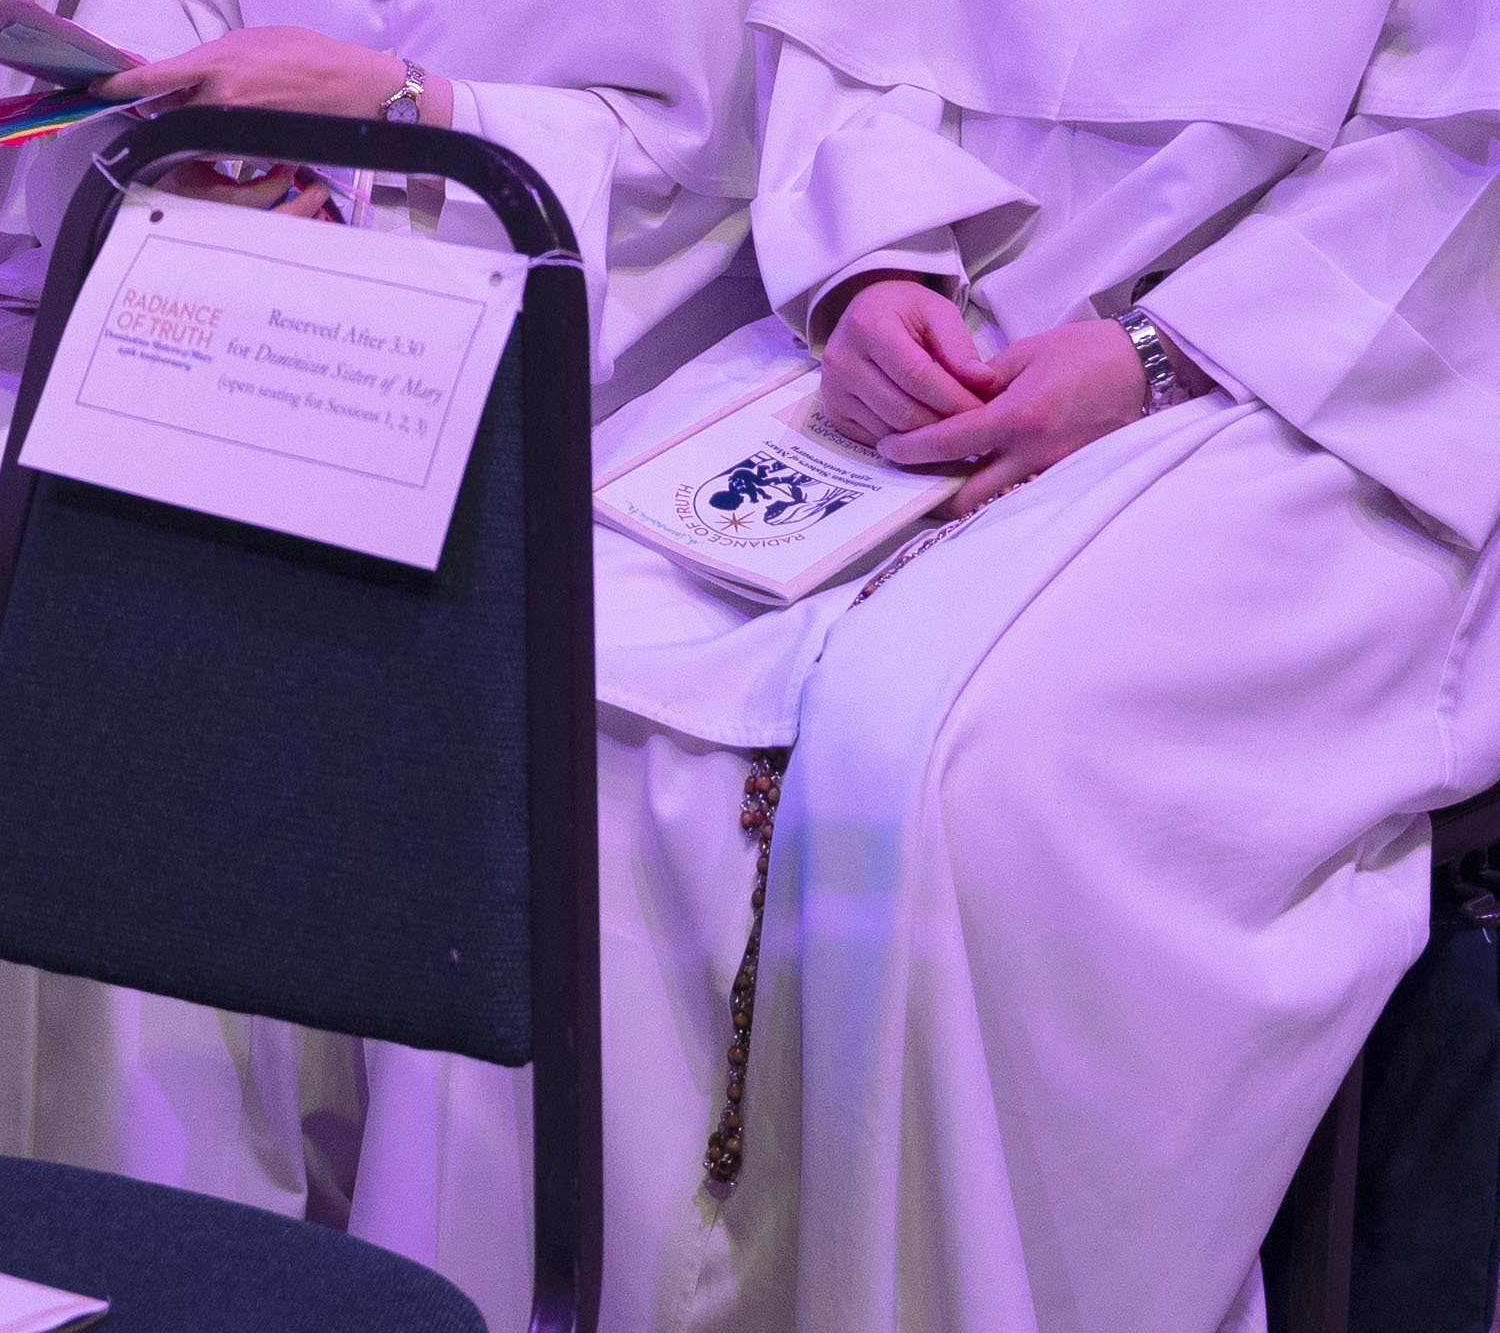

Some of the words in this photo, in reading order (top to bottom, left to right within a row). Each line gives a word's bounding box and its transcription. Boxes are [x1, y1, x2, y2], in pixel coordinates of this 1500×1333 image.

[123, 288, 223, 329] RADIANCE
[117, 311, 146, 331] OF
[150, 317, 213, 349] TRUTH
[268, 309, 341, 341] Reserved
[343, 326, 386, 351] After
[389, 336, 426, 358] 3:30
[227, 337, 251, 359] for
[254, 343, 329, 377] Dominican
[330, 361, 377, 388] Sisters
[379, 374, 399, 397] of
[400, 377, 442, 406] Mary
[217, 374, 255, 395] (open
[257, 386, 301, 409] seating
[303, 392, 323, 410] for
[325, 397, 379, 423] Sessions
[762, 440, 790, 457] Mary
[808, 423, 883, 460] ANNIVERSARY
[790, 446, 850, 475] Anniversary
[798, 459, 832, 477] Sisters
[832, 475, 882, 492] Dominican
[674, 483, 694, 522] TRUTH
[685, 521, 710, 537] OF
[707, 533, 806, 549] RADIANCE
